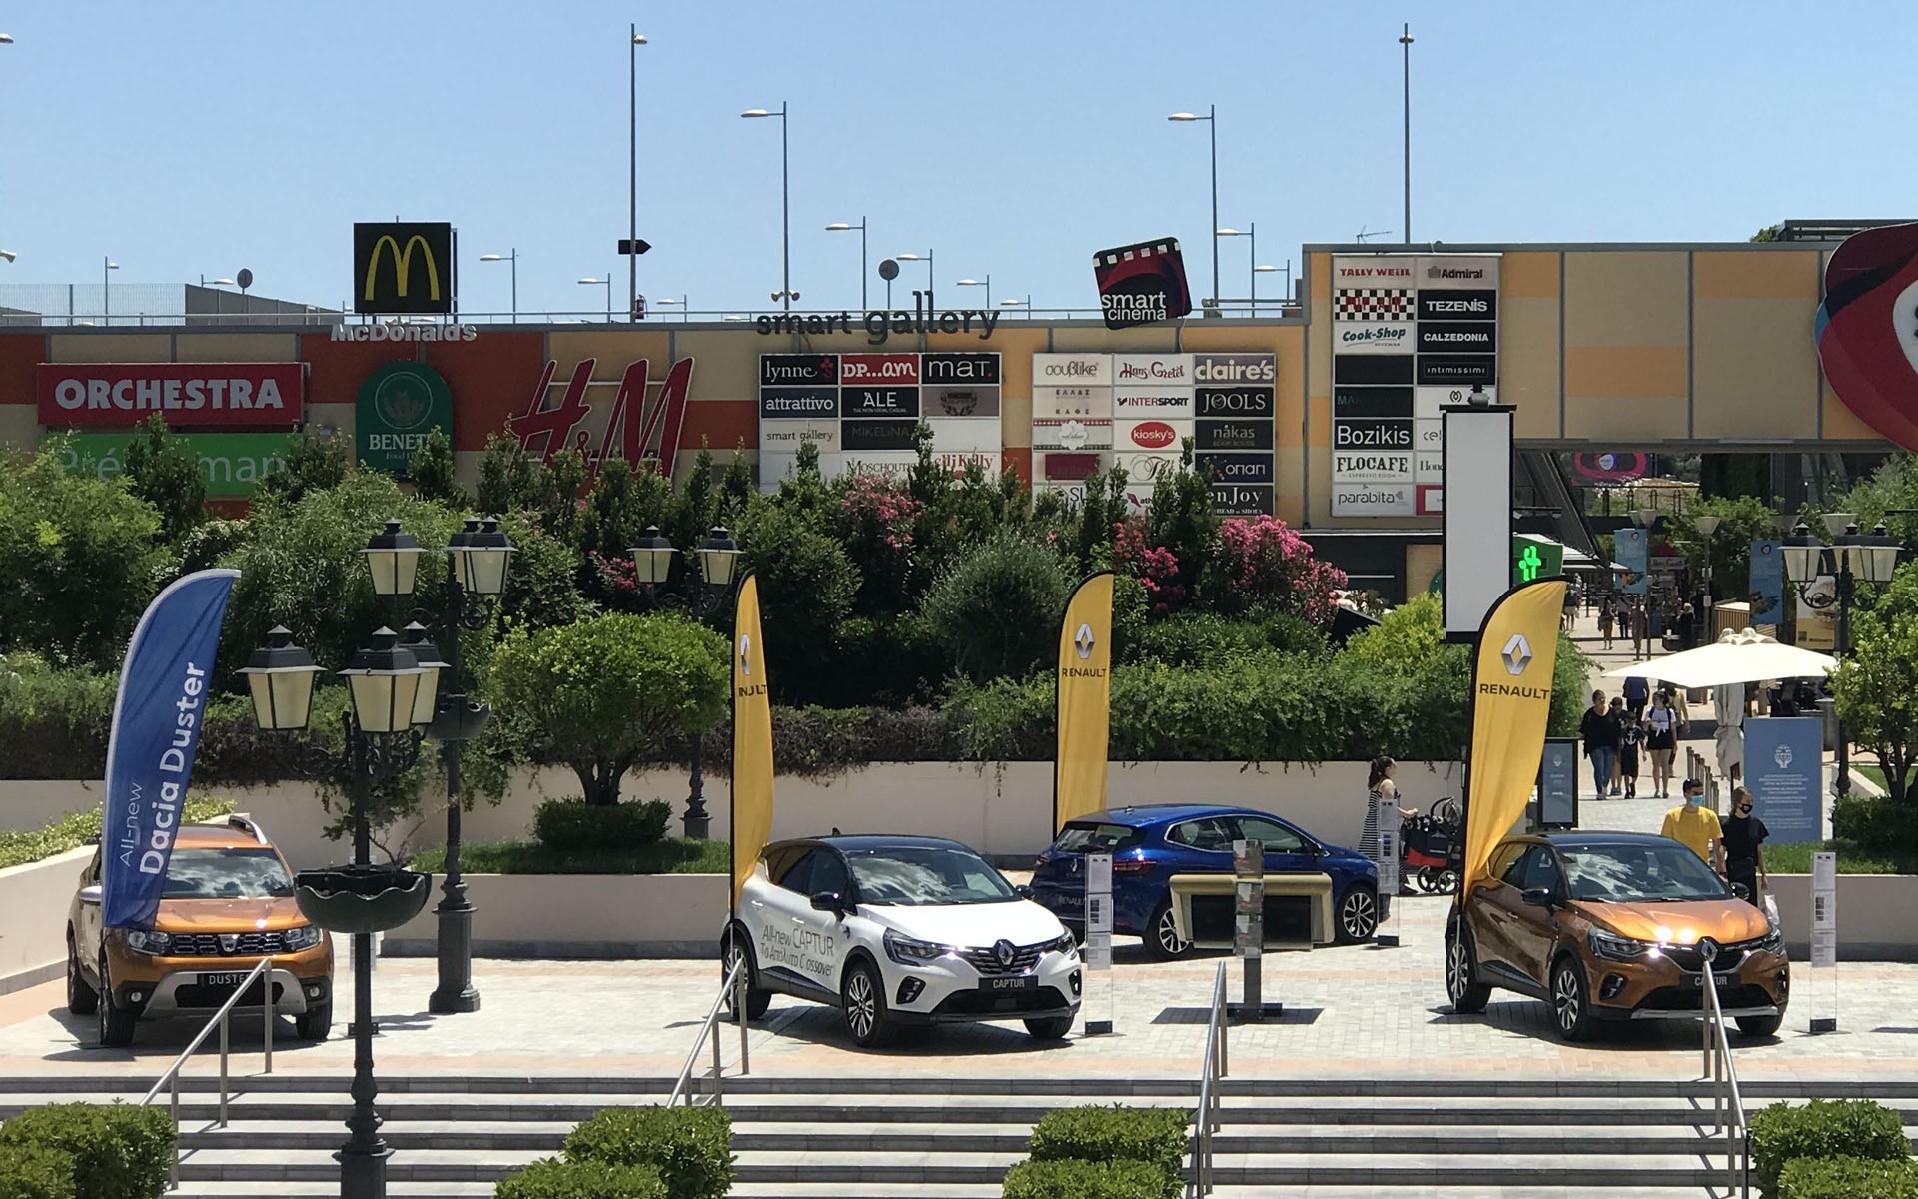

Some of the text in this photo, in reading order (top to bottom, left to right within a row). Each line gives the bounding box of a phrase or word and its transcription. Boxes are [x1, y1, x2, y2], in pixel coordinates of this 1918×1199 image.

[1441, 268, 1483, 279] Admiral
[1101, 291, 1167, 309] smart
[756, 290, 1000, 345] smart gallery
[1108, 308, 1167, 320] cinema
[331, 323, 478, 342] McDonald's
[1342, 327, 1407, 341] Cook-Shop
[1423, 333, 1489, 342] CALZEDONIA
[765, 361, 818, 383] lynne
[1195, 359, 1274, 381] claire's
[55, 378, 284, 410] ORCHESTRA
[1128, 397, 1189, 408] INTERSPORT
[765, 395, 834, 413] attrattivo
[1202, 393, 1266, 414] JOOLS
[503, 356, 695, 482] H&M
[766, 432, 796, 441] smart
[1133, 428, 1175, 443] kiosky's
[1337, 425, 1411, 445] Bozikis
[1336, 457, 1409, 473] FLOCAFE
[1338, 491, 1396, 505] parabita
[1061, 667, 1107, 678] RENAULT
[1479, 683, 1550, 700] RENAULT
[139, 661, 206, 876] Dacia Duster
[119, 780, 143, 869] All-new
[792, 927, 834, 957] CAPTUR
[992, 978, 1025, 989] CAPTUR
